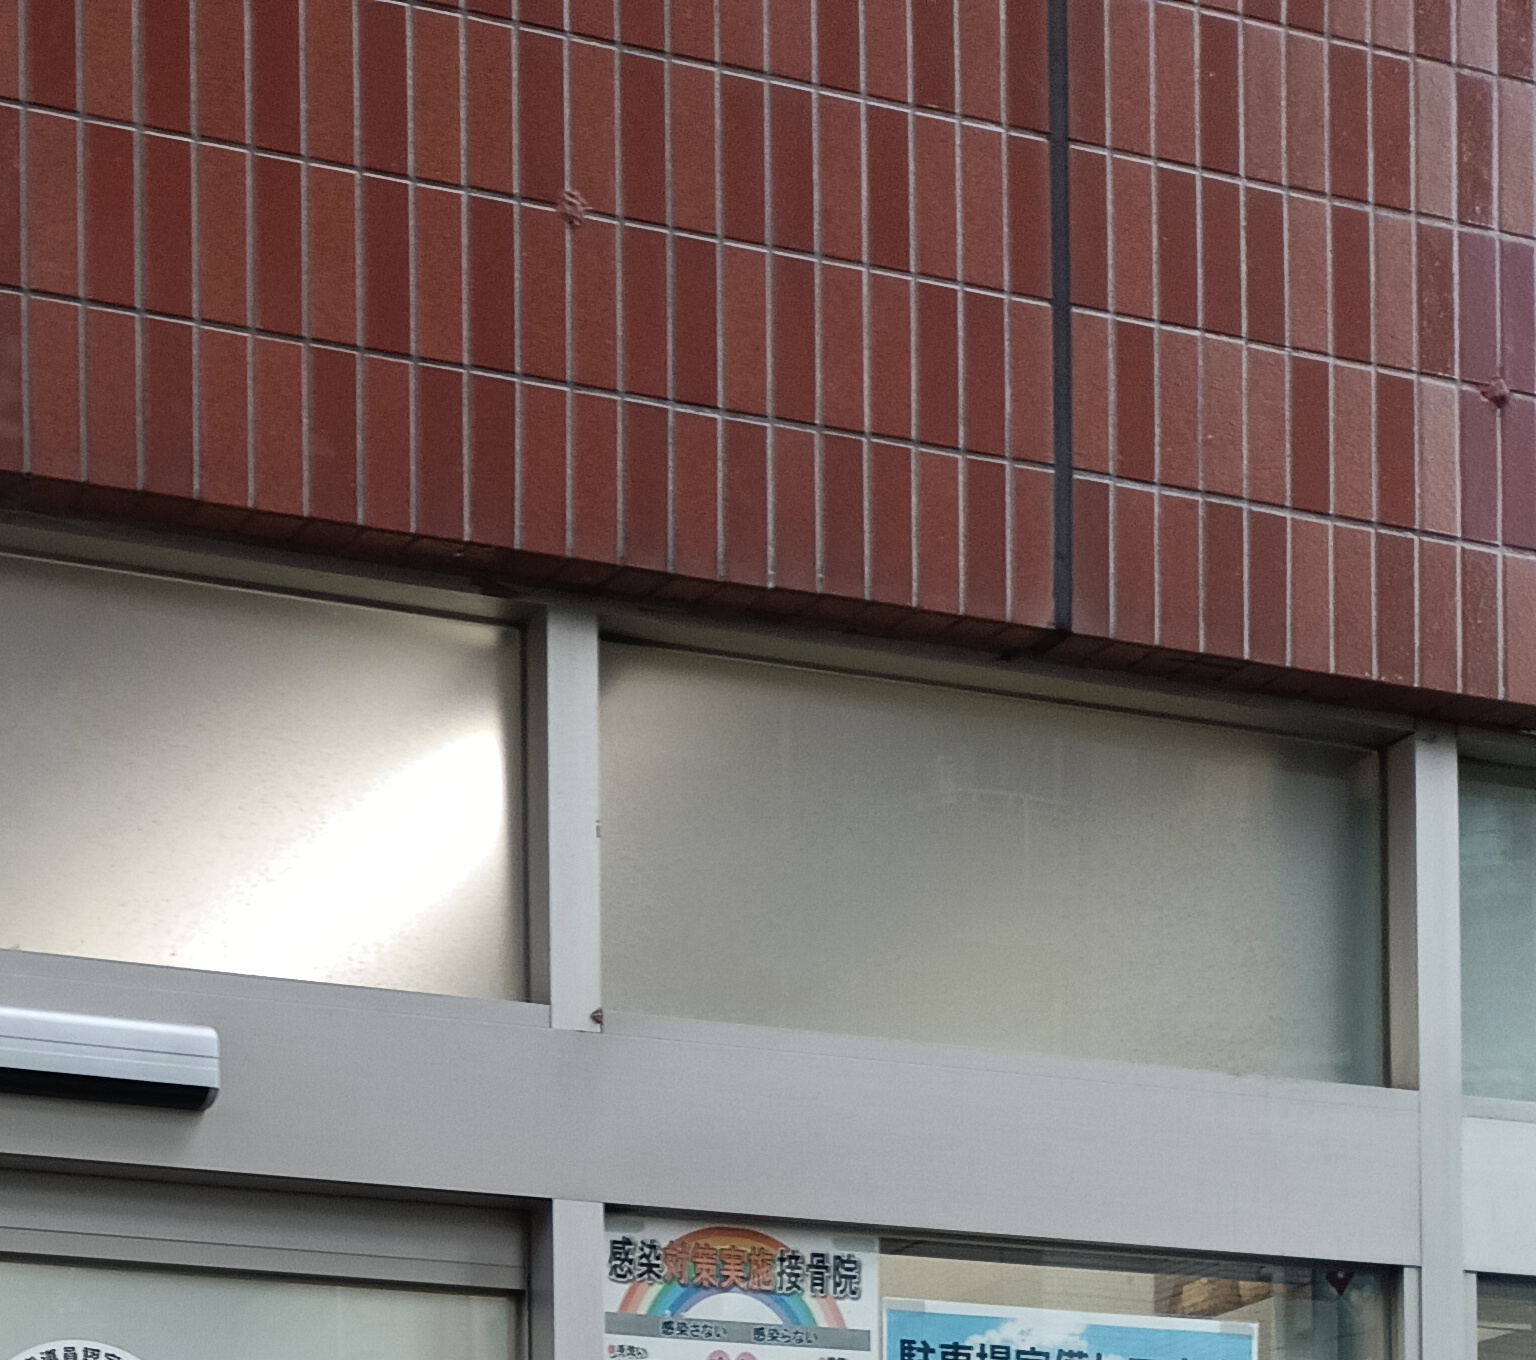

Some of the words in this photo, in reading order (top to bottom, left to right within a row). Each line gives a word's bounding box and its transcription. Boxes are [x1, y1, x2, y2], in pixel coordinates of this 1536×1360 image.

[607, 1236, 862, 1299] 感染対策実施接骨院
